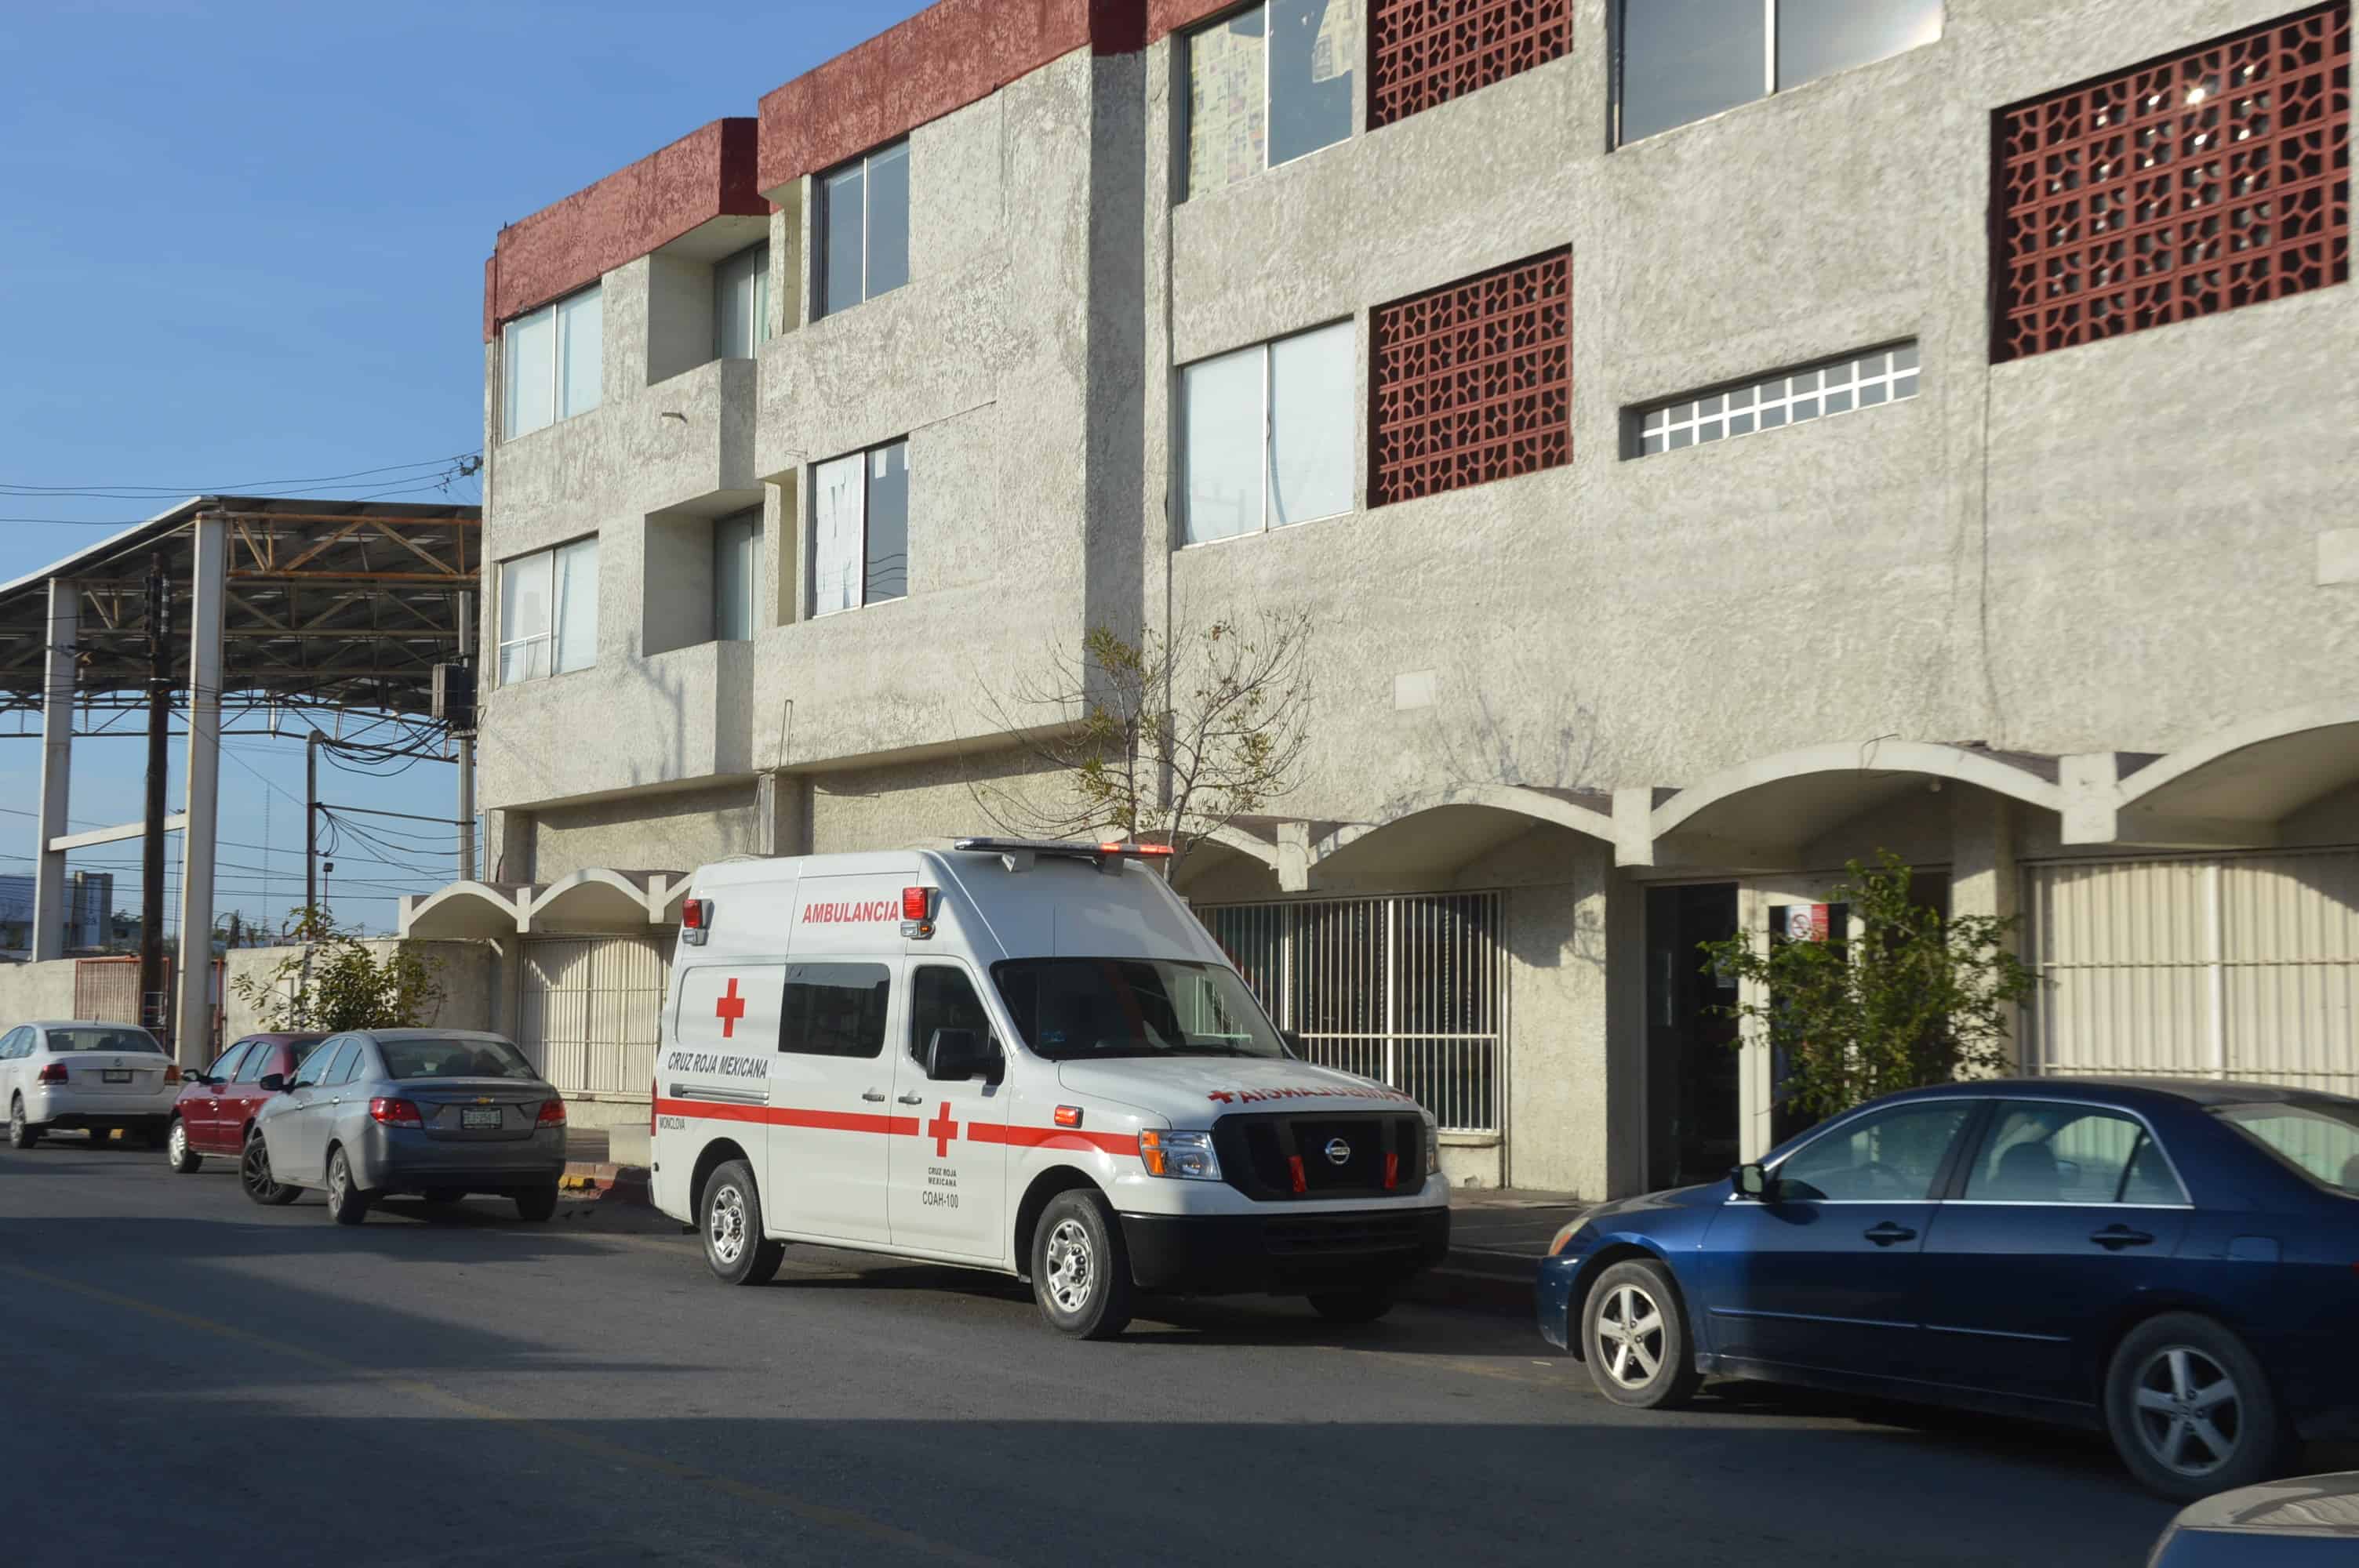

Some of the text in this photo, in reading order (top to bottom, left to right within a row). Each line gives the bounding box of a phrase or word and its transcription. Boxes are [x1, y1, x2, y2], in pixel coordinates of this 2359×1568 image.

[802, 901, 899, 923] AMBULANCIA
[668, 1052, 768, 1079] CRUZ ROJA MEXICANA
[659, 1116, 685, 1130] MONCLOVA
[928, 1167, 957, 1177] CRUZ ROJA
[928, 1177, 957, 1186] MEXICANA
[922, 1191, 959, 1208] COAH-100
